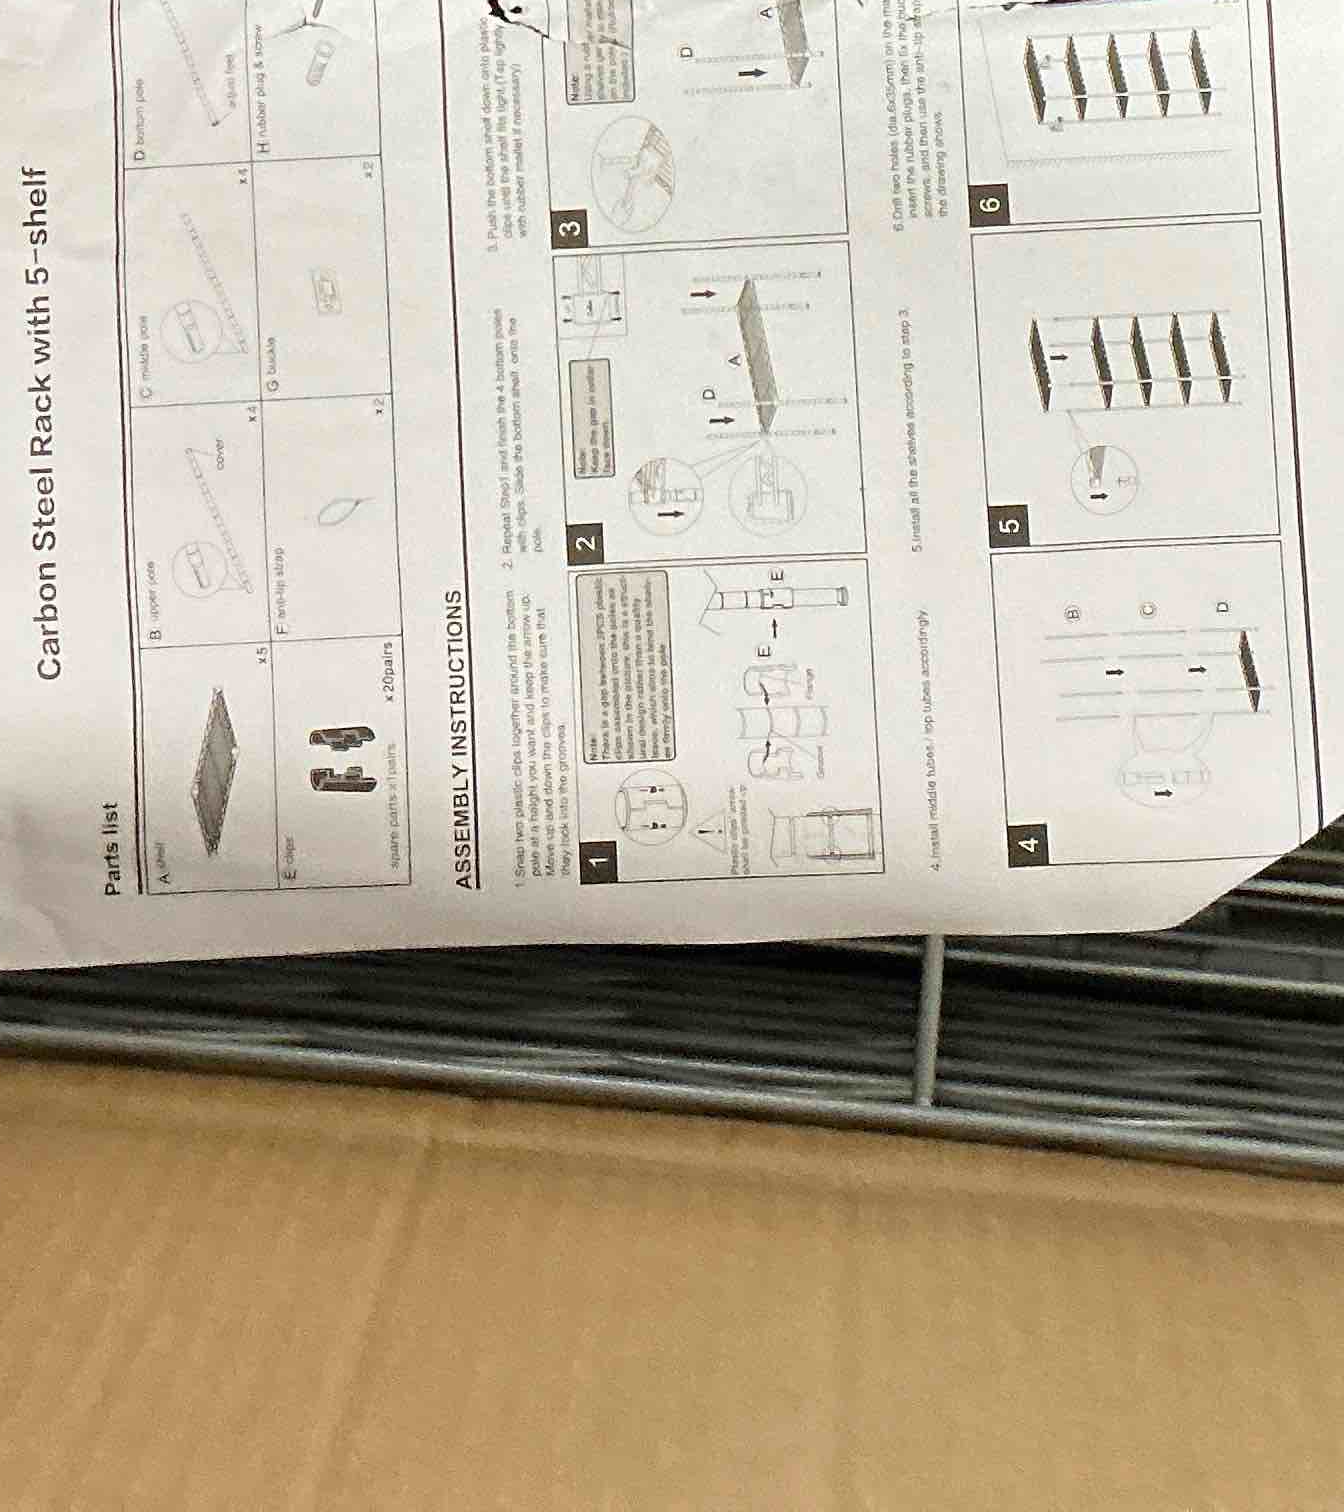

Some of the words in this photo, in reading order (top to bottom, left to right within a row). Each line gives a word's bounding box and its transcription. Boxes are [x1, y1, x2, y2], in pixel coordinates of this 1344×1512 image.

[759, 6, 772, 18] A
[679, 46, 694, 58] D
[255, 139, 270, 154] H
[131, 146, 146, 162] D
[979, 197, 1000, 211] 6
[21, 165, 49, 285] 5-shelf
[558, 220, 580, 236] 3
[25, 295, 51, 364] with
[727, 352, 741, 366] A
[265, 378, 279, 392] G
[138, 386, 154, 400] C
[701, 388, 716, 400] D
[27, 373, 52, 456] Rack
[28, 467, 56, 550] Steel
[998, 518, 1019, 532] 5
[575, 535, 595, 550] 2
[770, 569, 784, 581] E
[1215, 601, 1229, 612] D
[33, 562, 61, 680] Carbon
[273, 621, 289, 635] F
[146, 629, 162, 640] B
[757, 645, 771, 657] E
[444, 589, 467, 756] INSTRUCTIONS
[101, 801, 119, 834] list
[451, 763, 472, 889] ASSEMBLY
[1018, 837, 1038, 851] 4
[588, 857, 608, 865] 1
[103, 841, 121, 896] Parts
[282, 865, 297, 881] E
[156, 872, 171, 884] A
